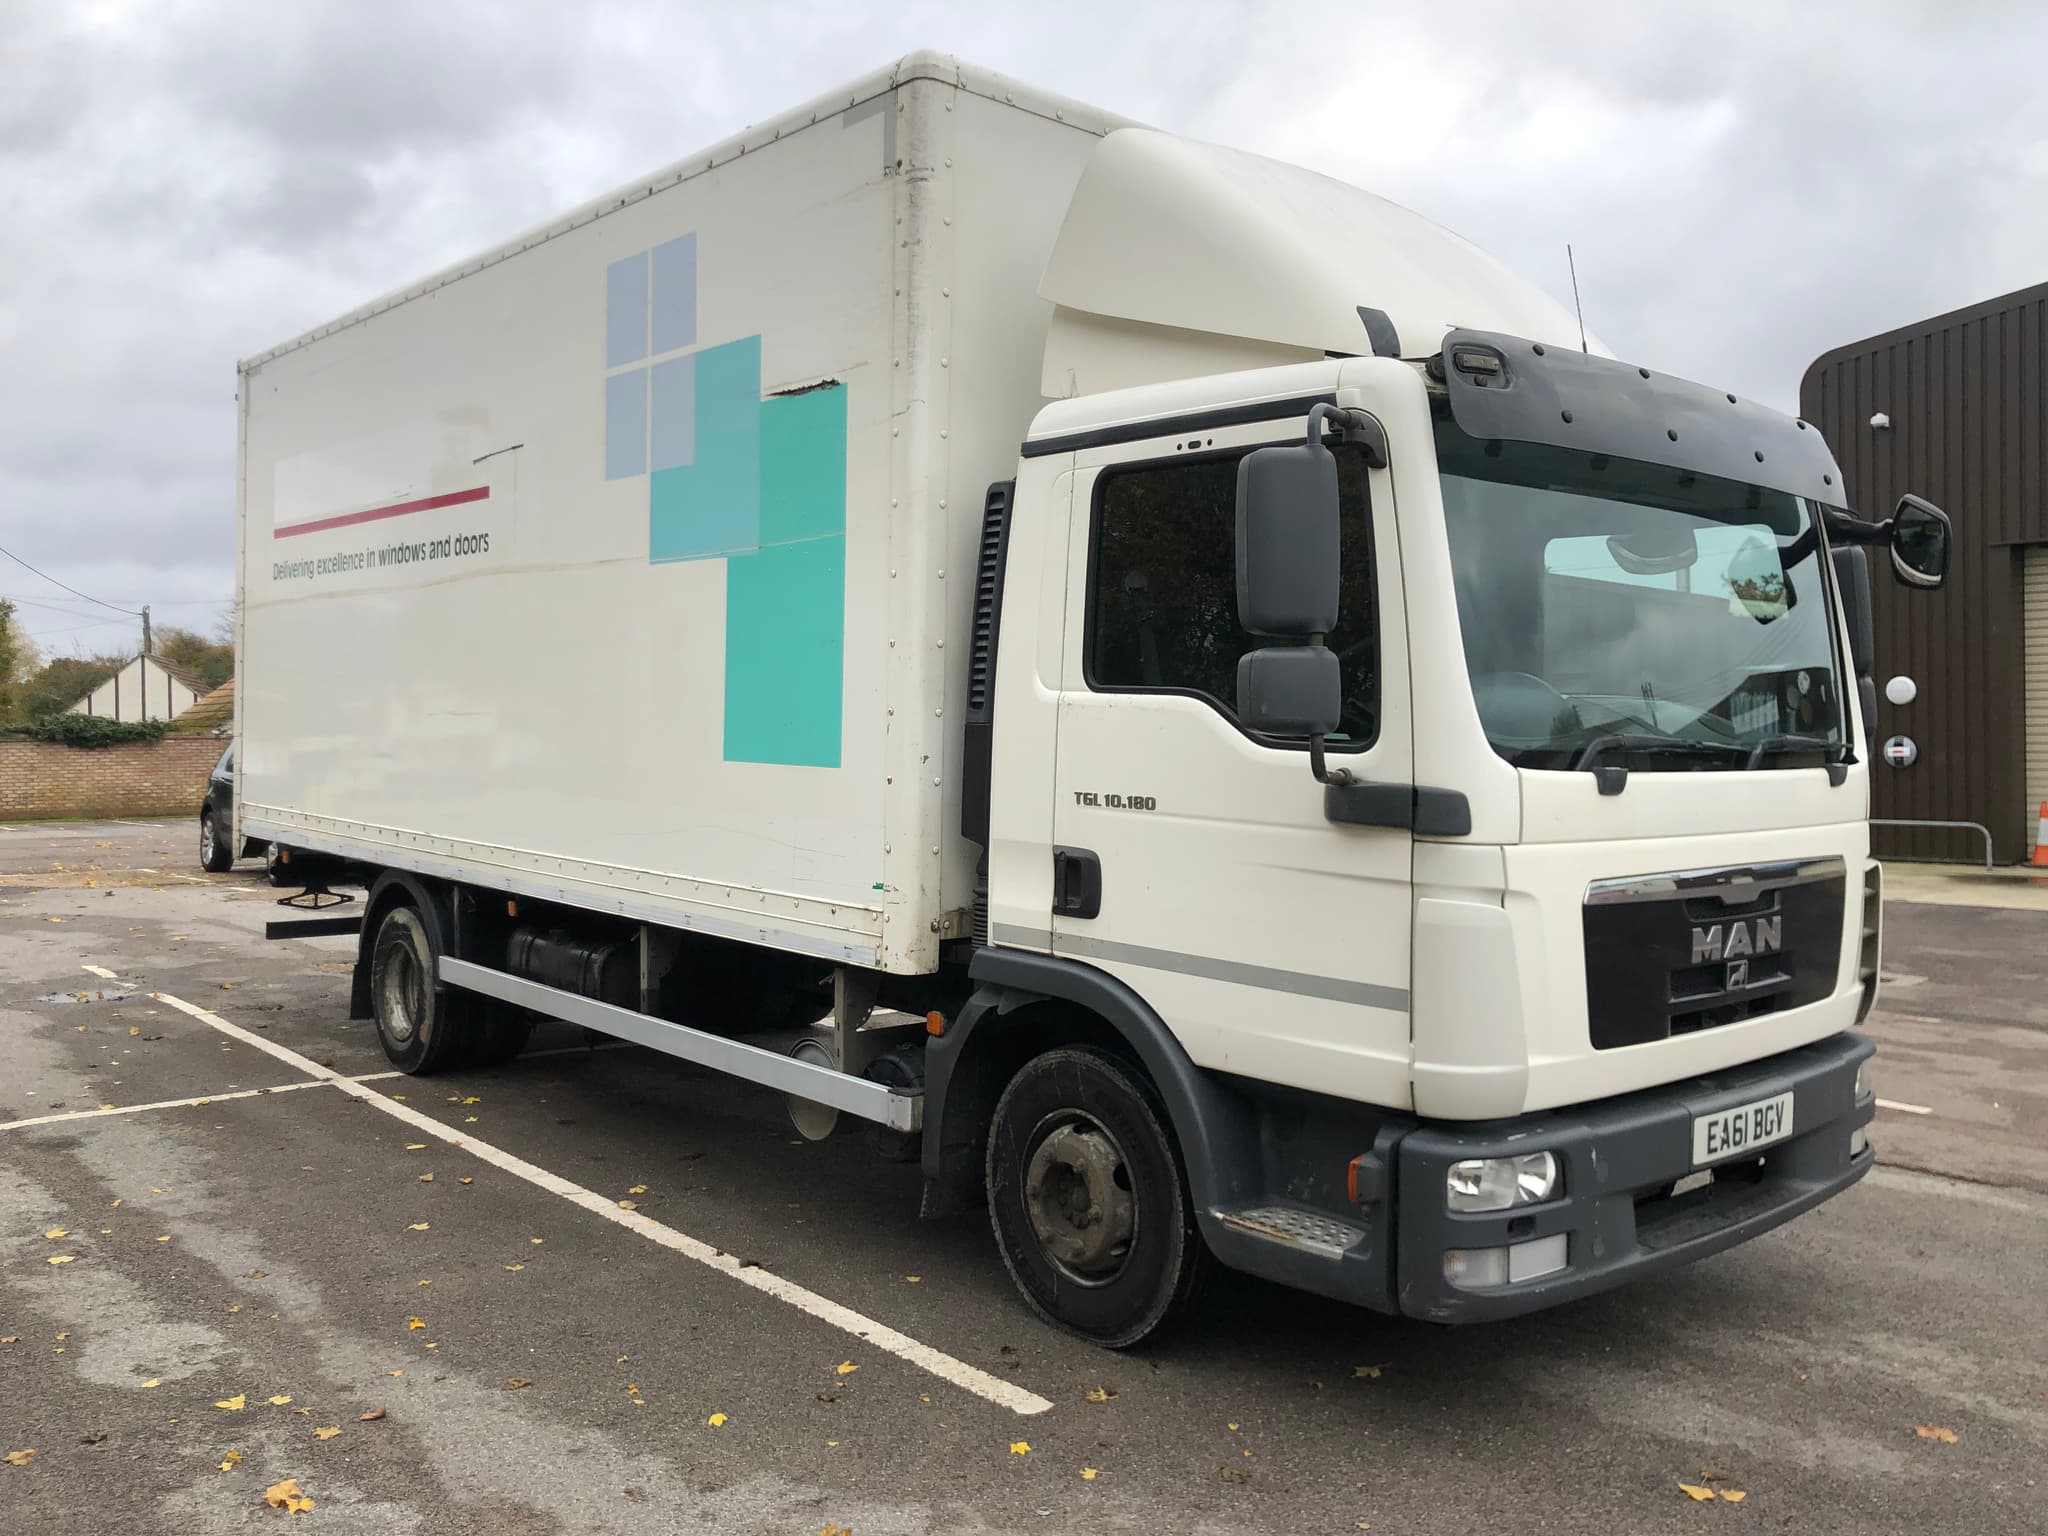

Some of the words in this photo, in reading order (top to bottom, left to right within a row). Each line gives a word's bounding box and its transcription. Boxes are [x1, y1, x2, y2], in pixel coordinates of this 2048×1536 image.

[273, 558, 315, 581] Delivering
[317, 552, 364, 576] excellence
[366, 547, 376, 569] in
[378, 541, 426, 567] windows
[429, 535, 452, 561] and
[454, 532, 490, 557] doors
[1074, 791, 1102, 807] TGL
[1104, 794, 1157, 811] 10.180
[1692, 915, 1782, 964] MAN
[1707, 1112, 1749, 1155] EA61
[1753, 1100, 1785, 1141] BGV
